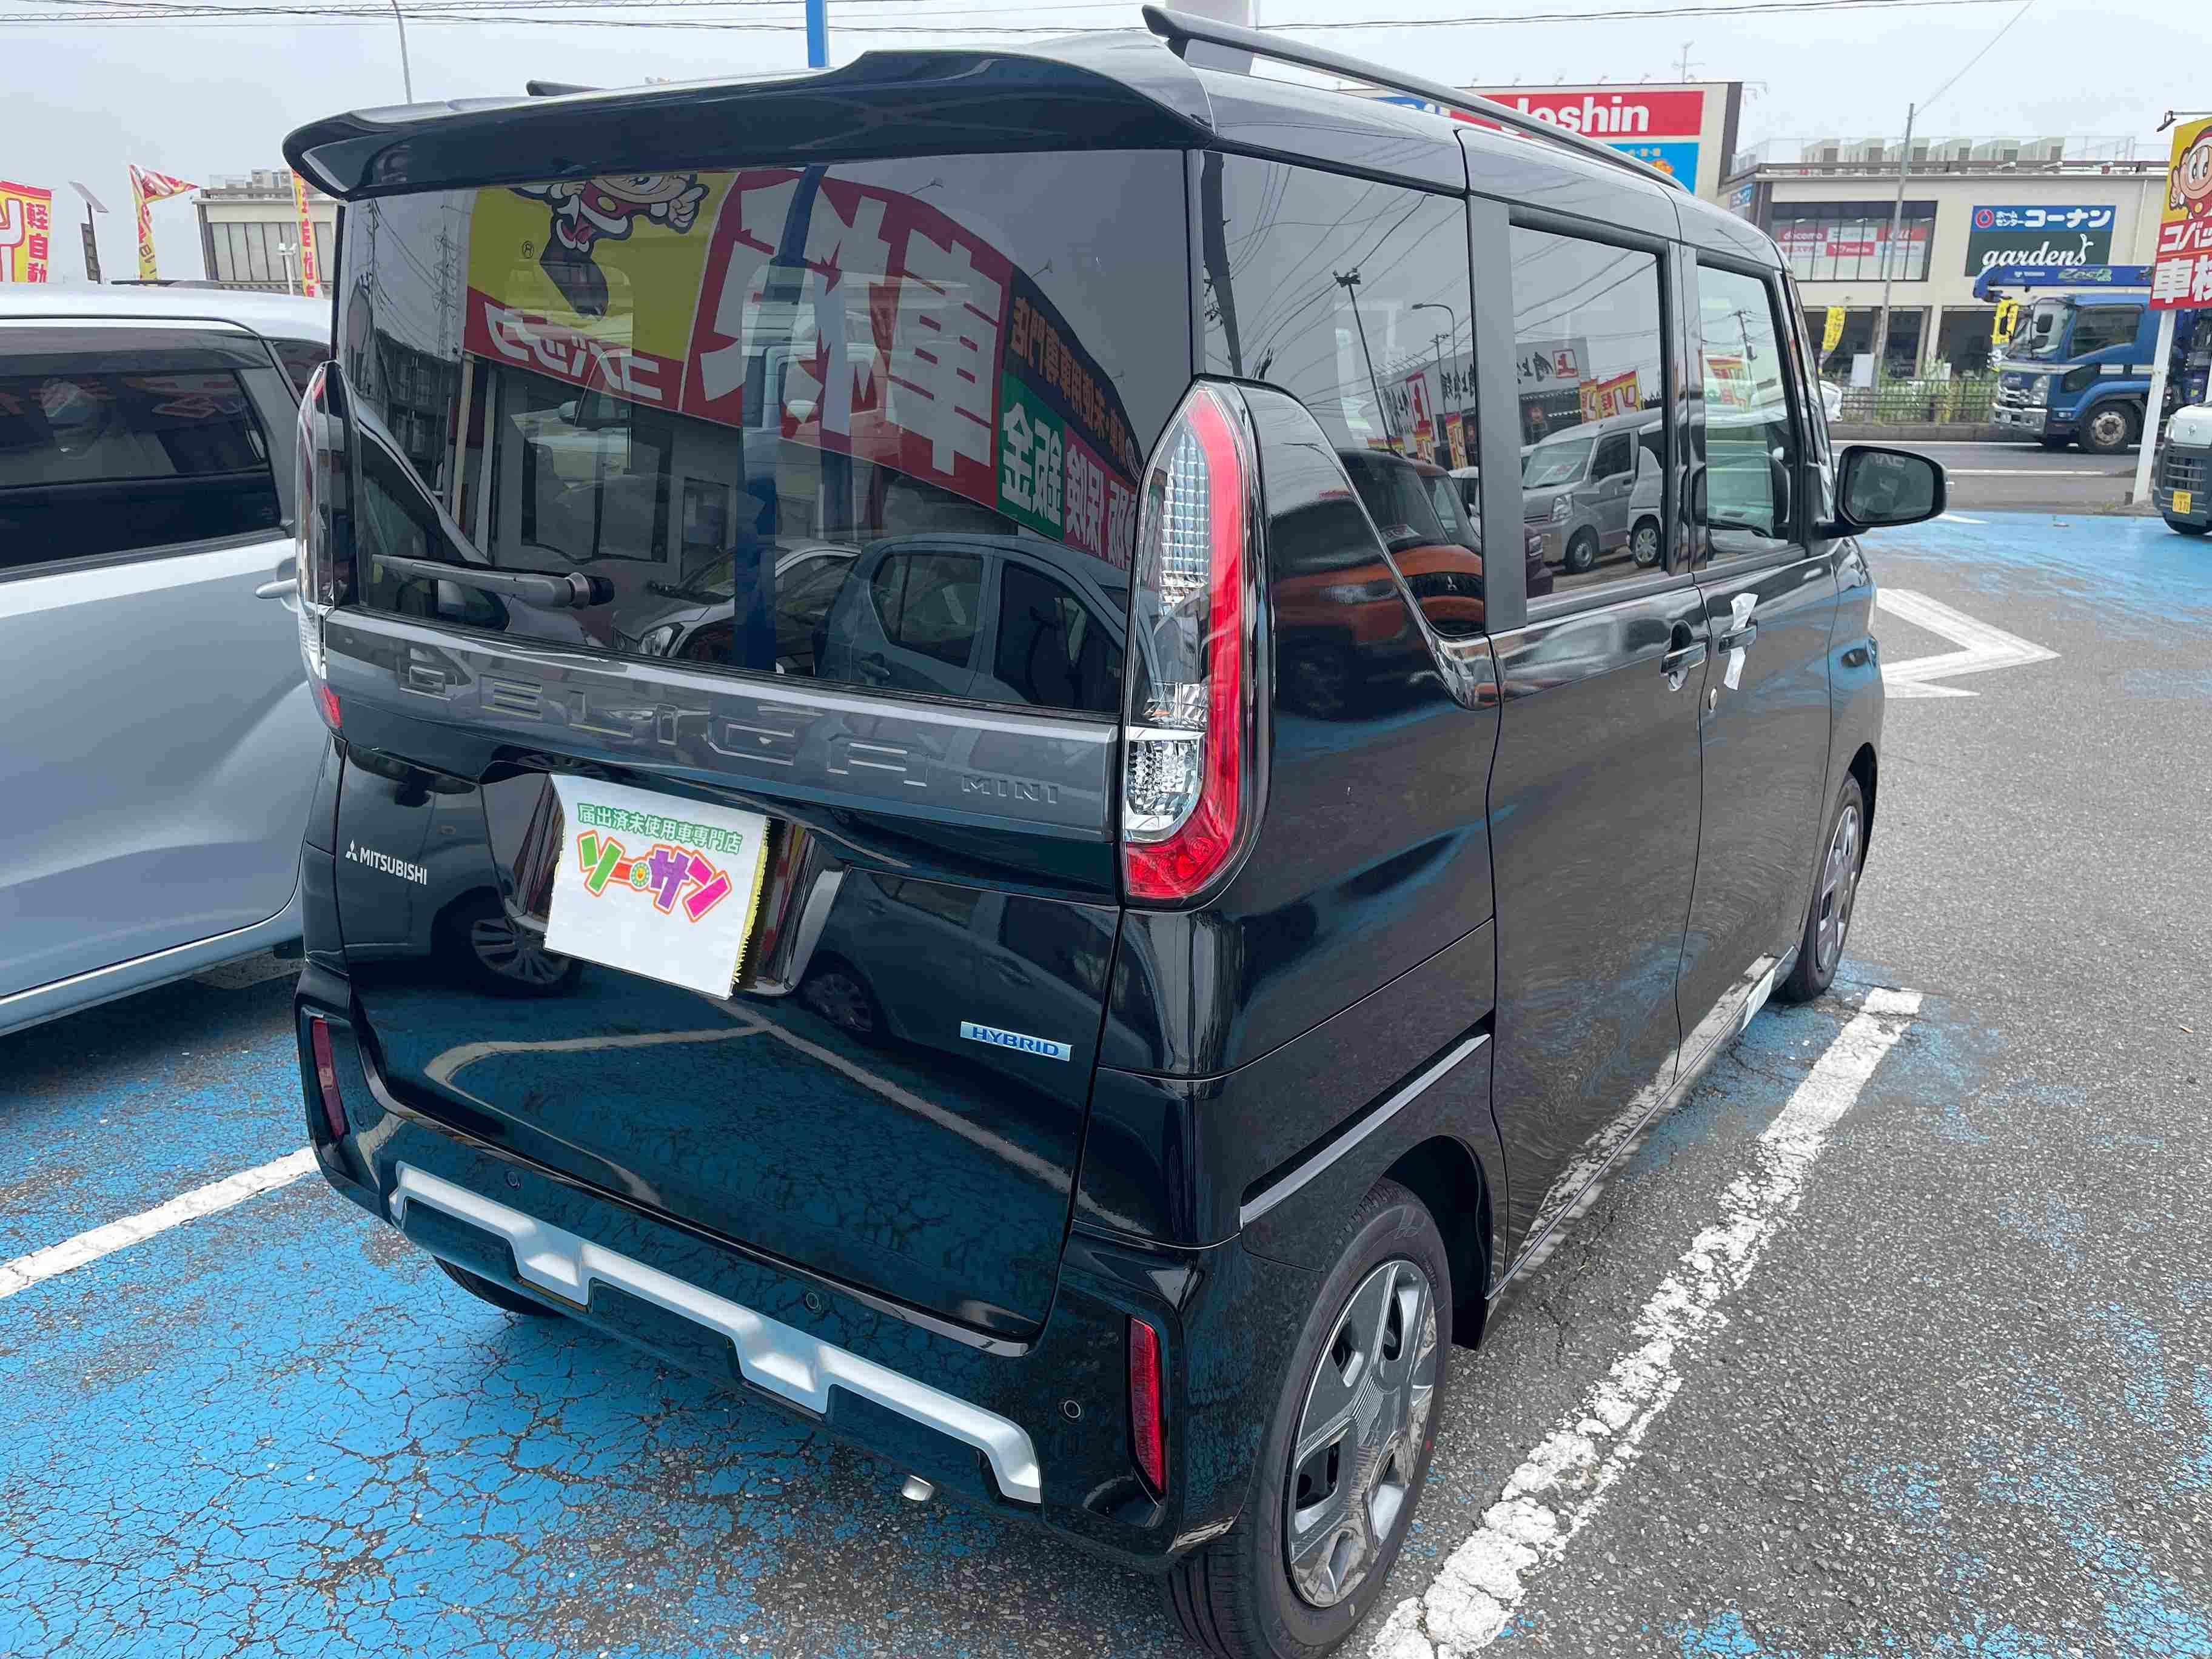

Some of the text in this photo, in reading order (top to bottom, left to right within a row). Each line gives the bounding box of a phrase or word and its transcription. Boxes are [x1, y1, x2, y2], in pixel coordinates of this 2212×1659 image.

[2025, 209, 2111, 228] コーナン
[1980, 233, 2094, 268] gardens
[962, 774, 1058, 804] MINI
[577, 802, 743, 855] 届出済未使用車専門店
[360, 847, 427, 885] MITSUBISHI
[972, 1027, 1059, 1057] HYBRID
